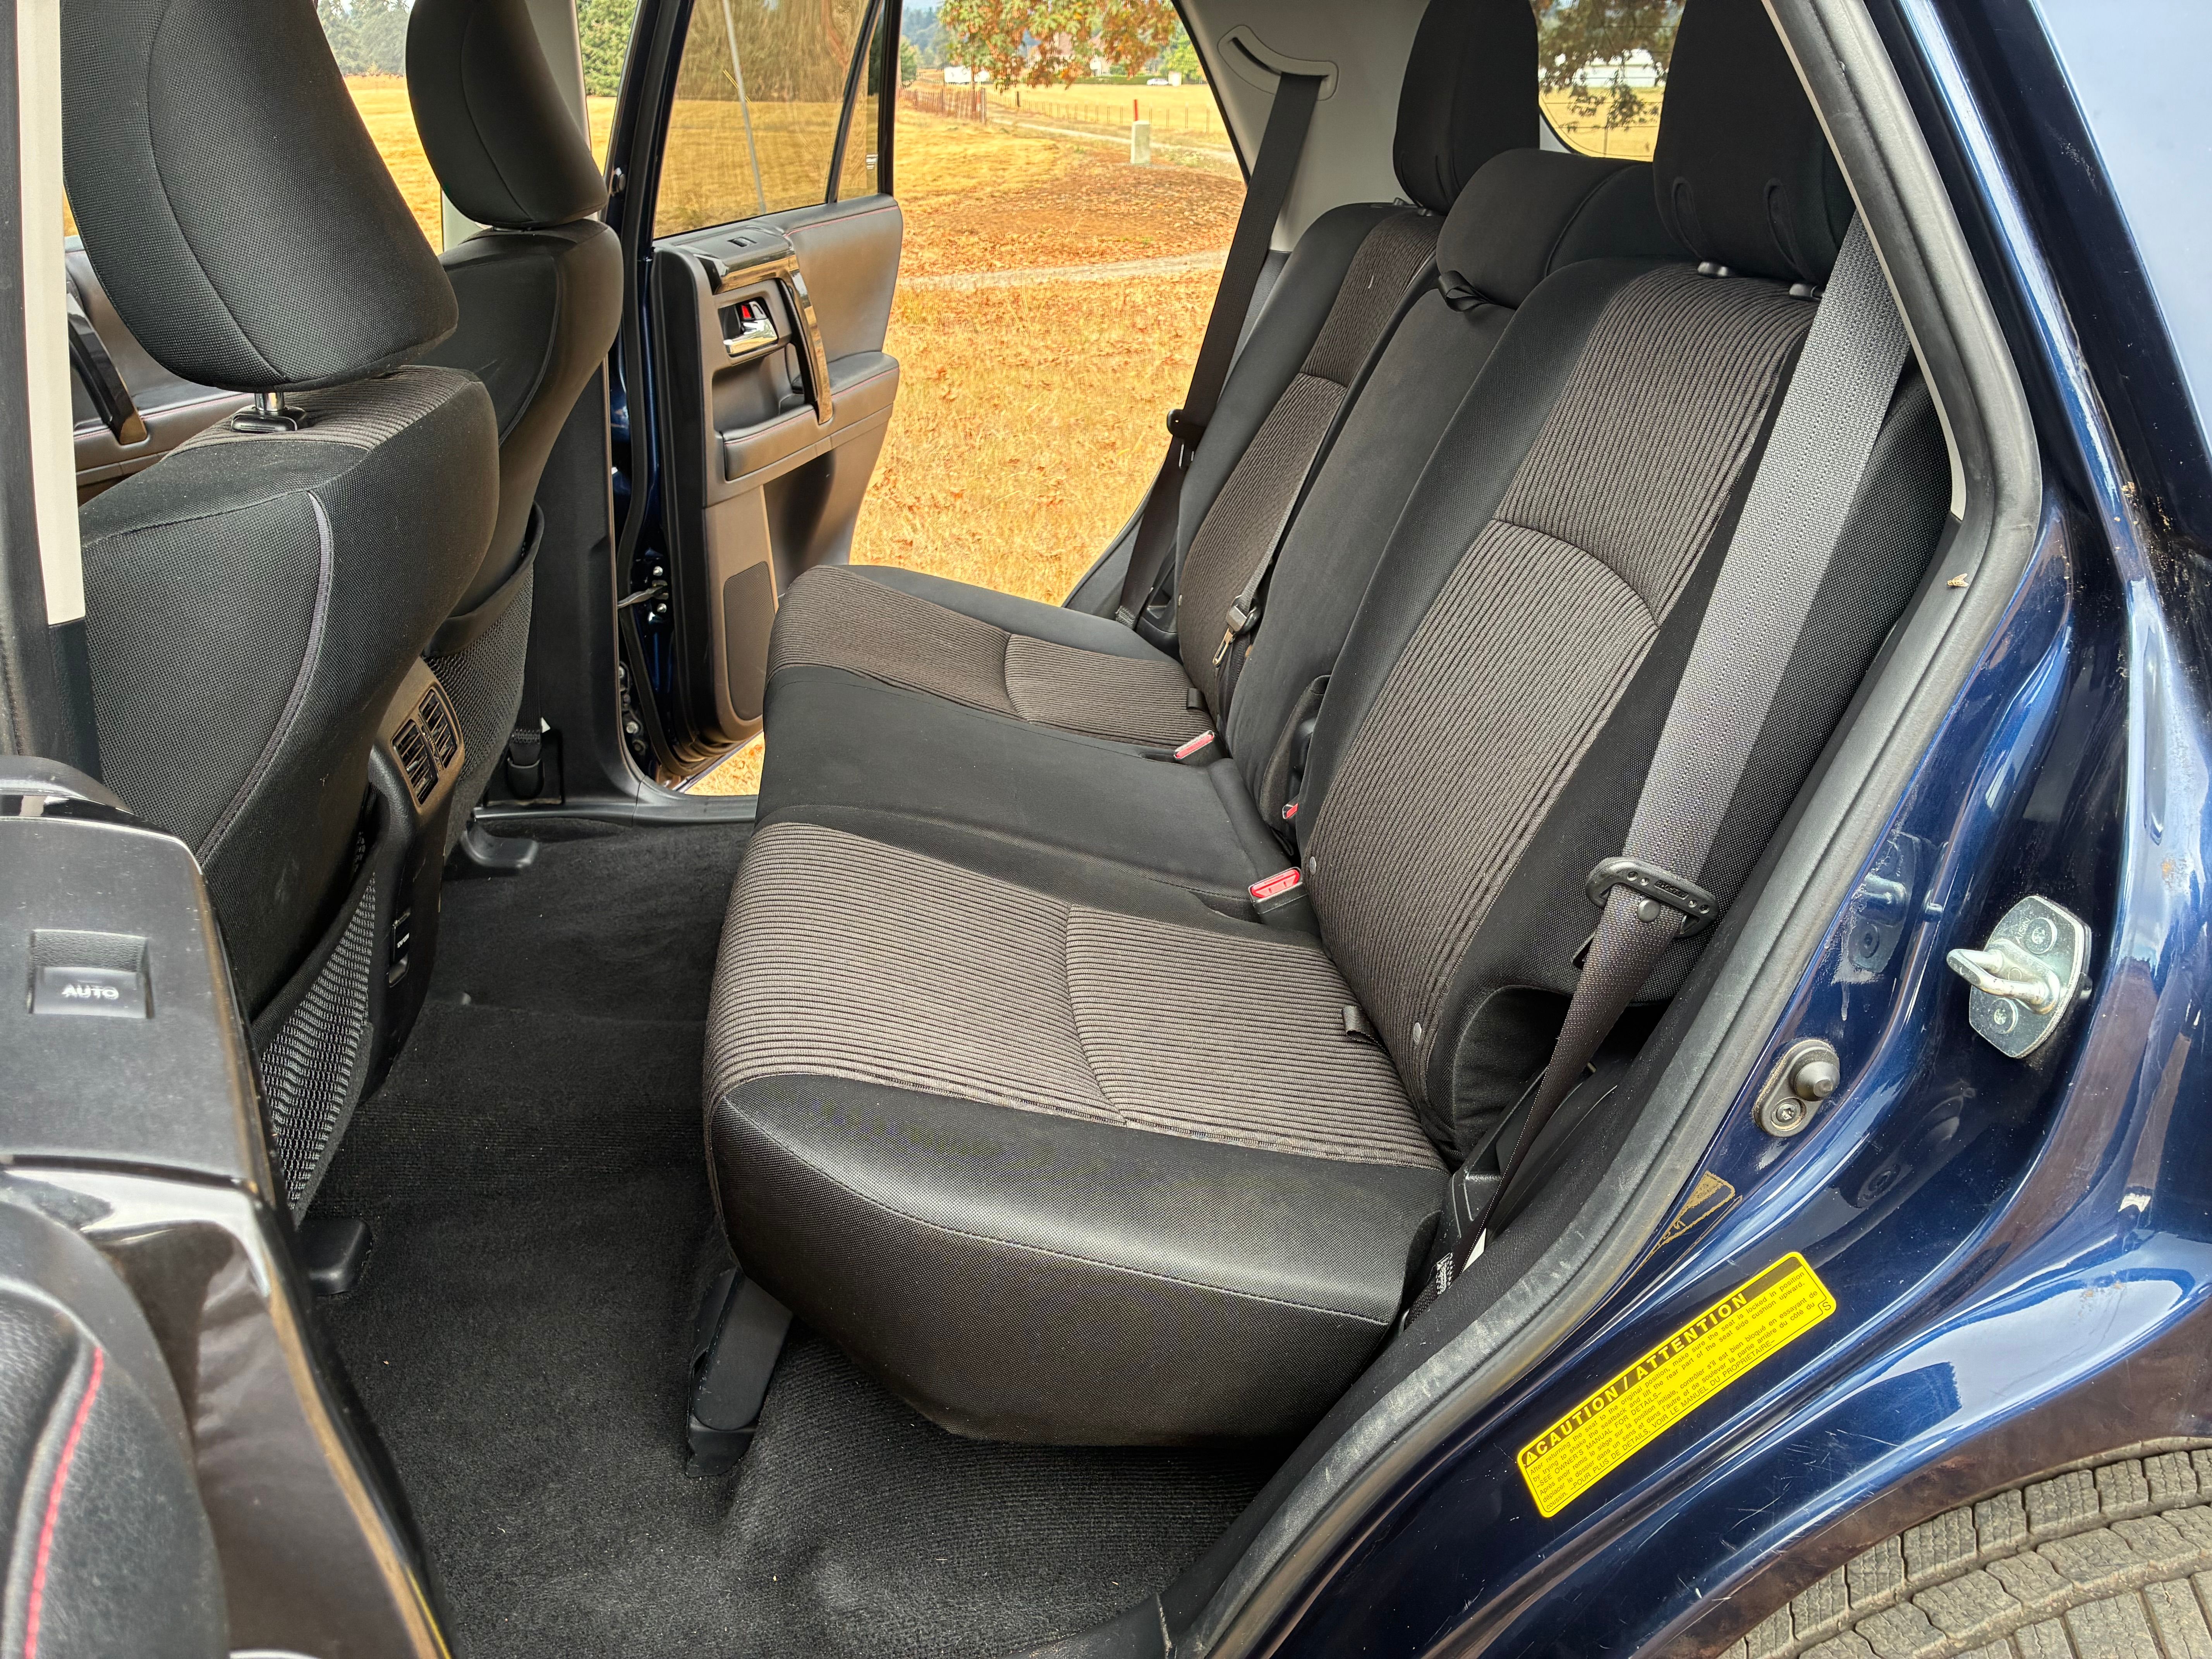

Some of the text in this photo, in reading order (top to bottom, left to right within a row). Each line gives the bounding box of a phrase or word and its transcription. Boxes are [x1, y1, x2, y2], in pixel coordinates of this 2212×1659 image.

[61, 984, 119, 1000] AUTO
[2015, 916, 2031, 944] AISIN
[1530, 1462, 1543, 1475] After
[1546, 1441, 1571, 1463] returning
[1573, 1432, 1582, 1441] the
[1585, 1420, 1598, 1432] seat
[1608, 1405, 1618, 1414] the
[1621, 1386, 1642, 1405] original
[1645, 1368, 1670, 1388] position,
[1672, 1353, 1689, 1367] make
[1692, 1341, 1705, 1353] sure
[1707, 1332, 1718, 1341] the
[1721, 1319, 1735, 1331] seat
[1746, 1296, 1767, 1314] locked
[1779, 1272, 1805, 1292] position
[1536, 1293, 1747, 1452] CAUTION / ATTENTION
[1542, 1460, 1559, 1474] trying
[1569, 1439, 1586, 1453] shake
[1589, 1429, 1598, 1439] the
[1601, 1408, 1627, 1429] seatback
[1629, 1396, 1641, 1408] and
[1642, 1389, 1652, 1398] lift
[1653, 1381, 1664, 1389] the
[1666, 1369, 1678, 1381] rear
[1681, 1358, 1694, 1370] part
[1705, 1342, 1716, 1352] the
[1719, 1330, 1733, 1342] seat
[1735, 1319, 1749, 1331] side
[1752, 1300, 1776, 1319] cushion
[1779, 1281, 1805, 1300] upward.
[1822, 1302, 1831, 1311] S
[1540, 1481, 1556, 1496] Après
[1557, 1469, 1570, 1482] avoir
[1572, 1456, 1588, 1470] remis
[1597, 1437, 1613, 1451] siège
[1614, 1428, 1623, 1438] sur
[1633, 1405, 1656, 1425] position
[1657, 1390, 1678, 1406] initiale,
[1680, 1369, 1705, 1389] contrôler
[1707, 1360, 1716, 1369] s'il
[1718, 1352, 1728, 1361] est
[1729, 1342, 1744, 1353] bien
[1745, 1325, 1766, 1342] bloqué
[1779, 1298, 1807, 1319] essayant
[1543, 1482, 1565, 1503] déplacer
[1575, 1460, 1594, 1477] dossier
[1597, 1448, 1611, 1461] dans
[1622, 1429, 1636, 1441] sens
[1646, 1411, 1661, 1424] dans
[1662, 1396, 1681, 1412] l'autre
[1702, 1363, 1726, 1383] soulever
[1737, 1343, 1755, 1358] partie
[1757, 1328, 1777, 1344] arrière
[1790, 1309, 1804, 1321] côté
[1546, 1492, 1568, 1510] coussin.
[1592, 1458, 1609, 1474] PLUS
[1611, 1449, 1621, 1460] DE
[1622, 1429, 1650, 1451] DÉTAILS,
[1651, 1414, 1669, 1428] VOIR
[1669, 1406, 1680, 1415] LE
[1680, 1386, 1709, 1407] MANUEL
[1709, 1376, 1720, 1386] DU
[1554, 1449, 1584, 1474] OWNER'S
[1586, 1428, 1613, 1450] MANUAL
[1614, 1415, 1629, 1428] FOR
